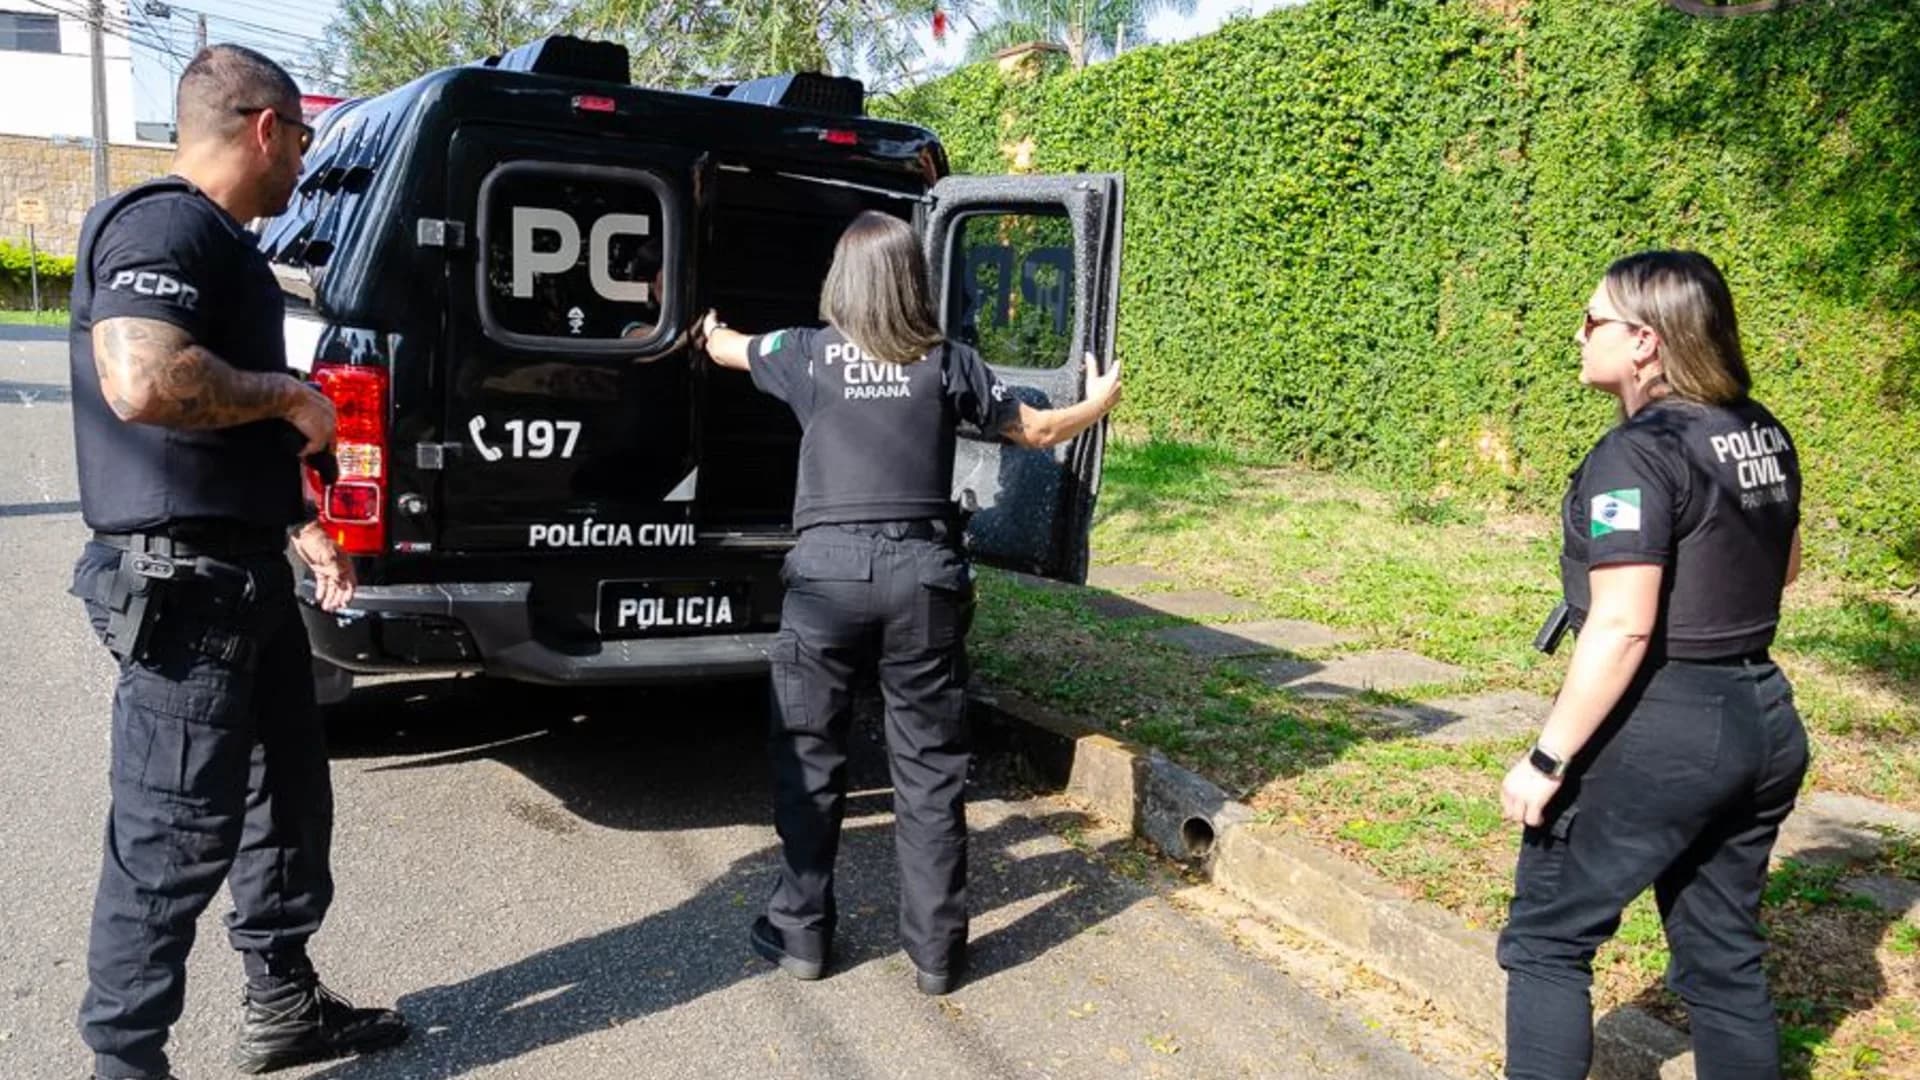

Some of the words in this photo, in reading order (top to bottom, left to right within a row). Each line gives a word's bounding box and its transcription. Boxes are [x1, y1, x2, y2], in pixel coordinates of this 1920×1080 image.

[513, 206, 649, 303] PC
[110, 271, 199, 310] PCPR
[844, 362, 911, 384] CIVIL
[844, 382, 911, 399] PARANÁ
[504, 419, 582, 458] 197
[1710, 422, 1790, 463] POLÍCIA
[1738, 456, 1786, 489] CIVIL
[528, 517, 633, 547] POLÍCIA
[638, 523, 696, 547] CIVIL
[618, 596, 732, 629] POLICIA
